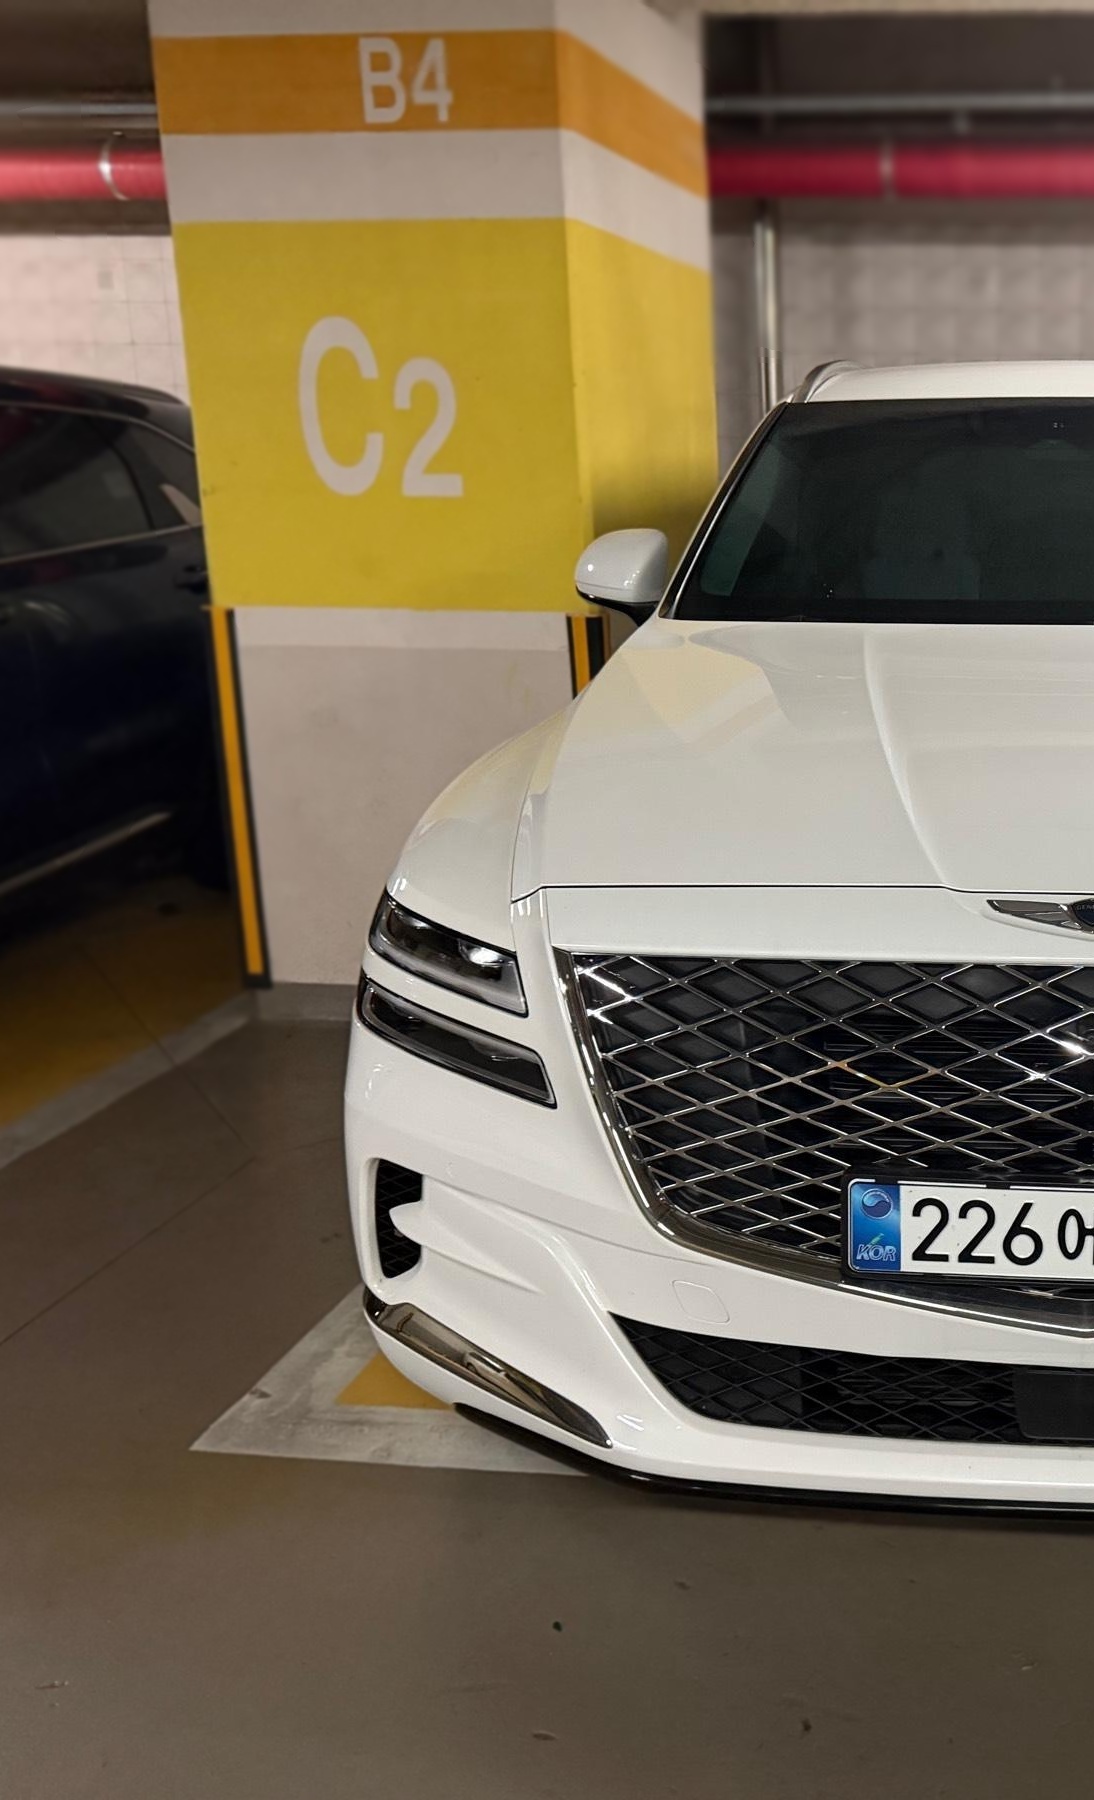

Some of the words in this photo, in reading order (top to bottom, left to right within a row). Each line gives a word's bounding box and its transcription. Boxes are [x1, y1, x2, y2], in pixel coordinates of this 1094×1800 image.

[358, 37, 453, 124] B4
[298, 316, 464, 497] C2
[856, 1244, 896, 1261] KOR
